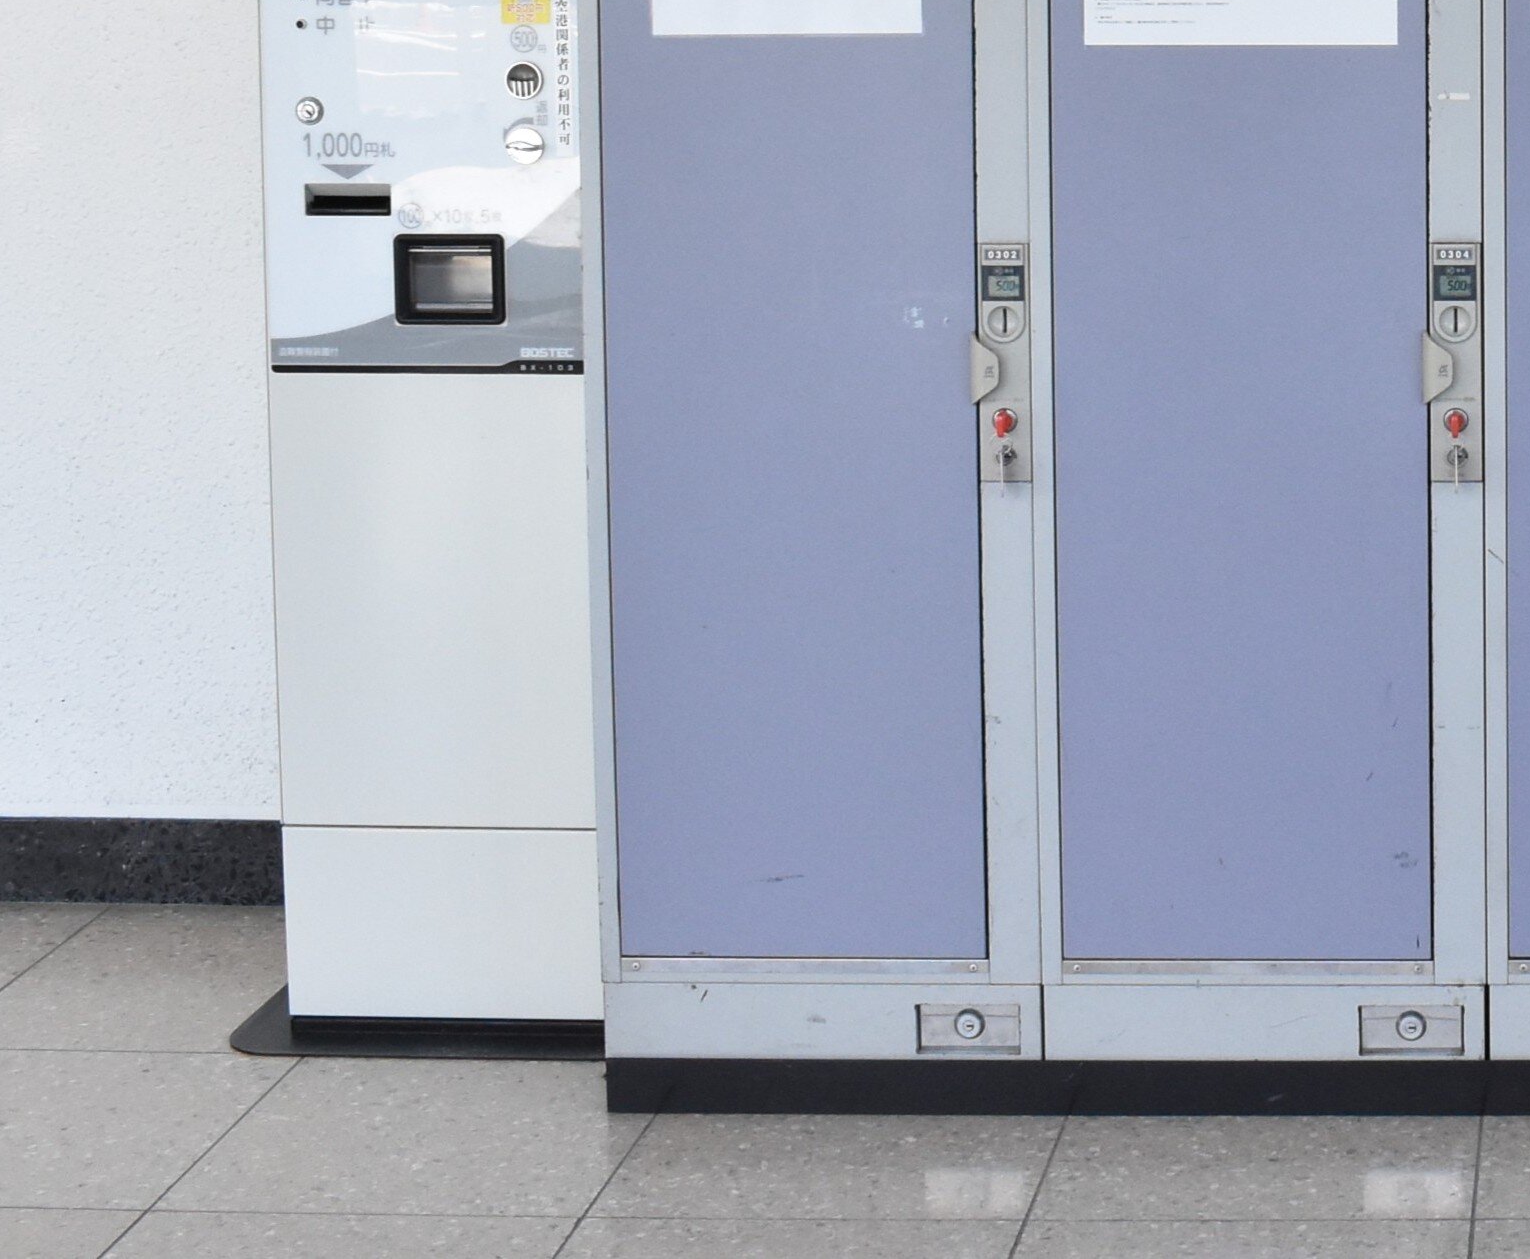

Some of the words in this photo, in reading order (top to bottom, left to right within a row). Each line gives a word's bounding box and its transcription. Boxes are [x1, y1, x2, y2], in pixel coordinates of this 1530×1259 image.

[555, 0, 571, 145] 空港関係者の利用不可
[302, 132, 396, 160] 1,000円札
[988, 250, 1017, 259] 0302
[1440, 249, 1469, 259] 0304
[520, 347, 575, 358] BOSTEC
